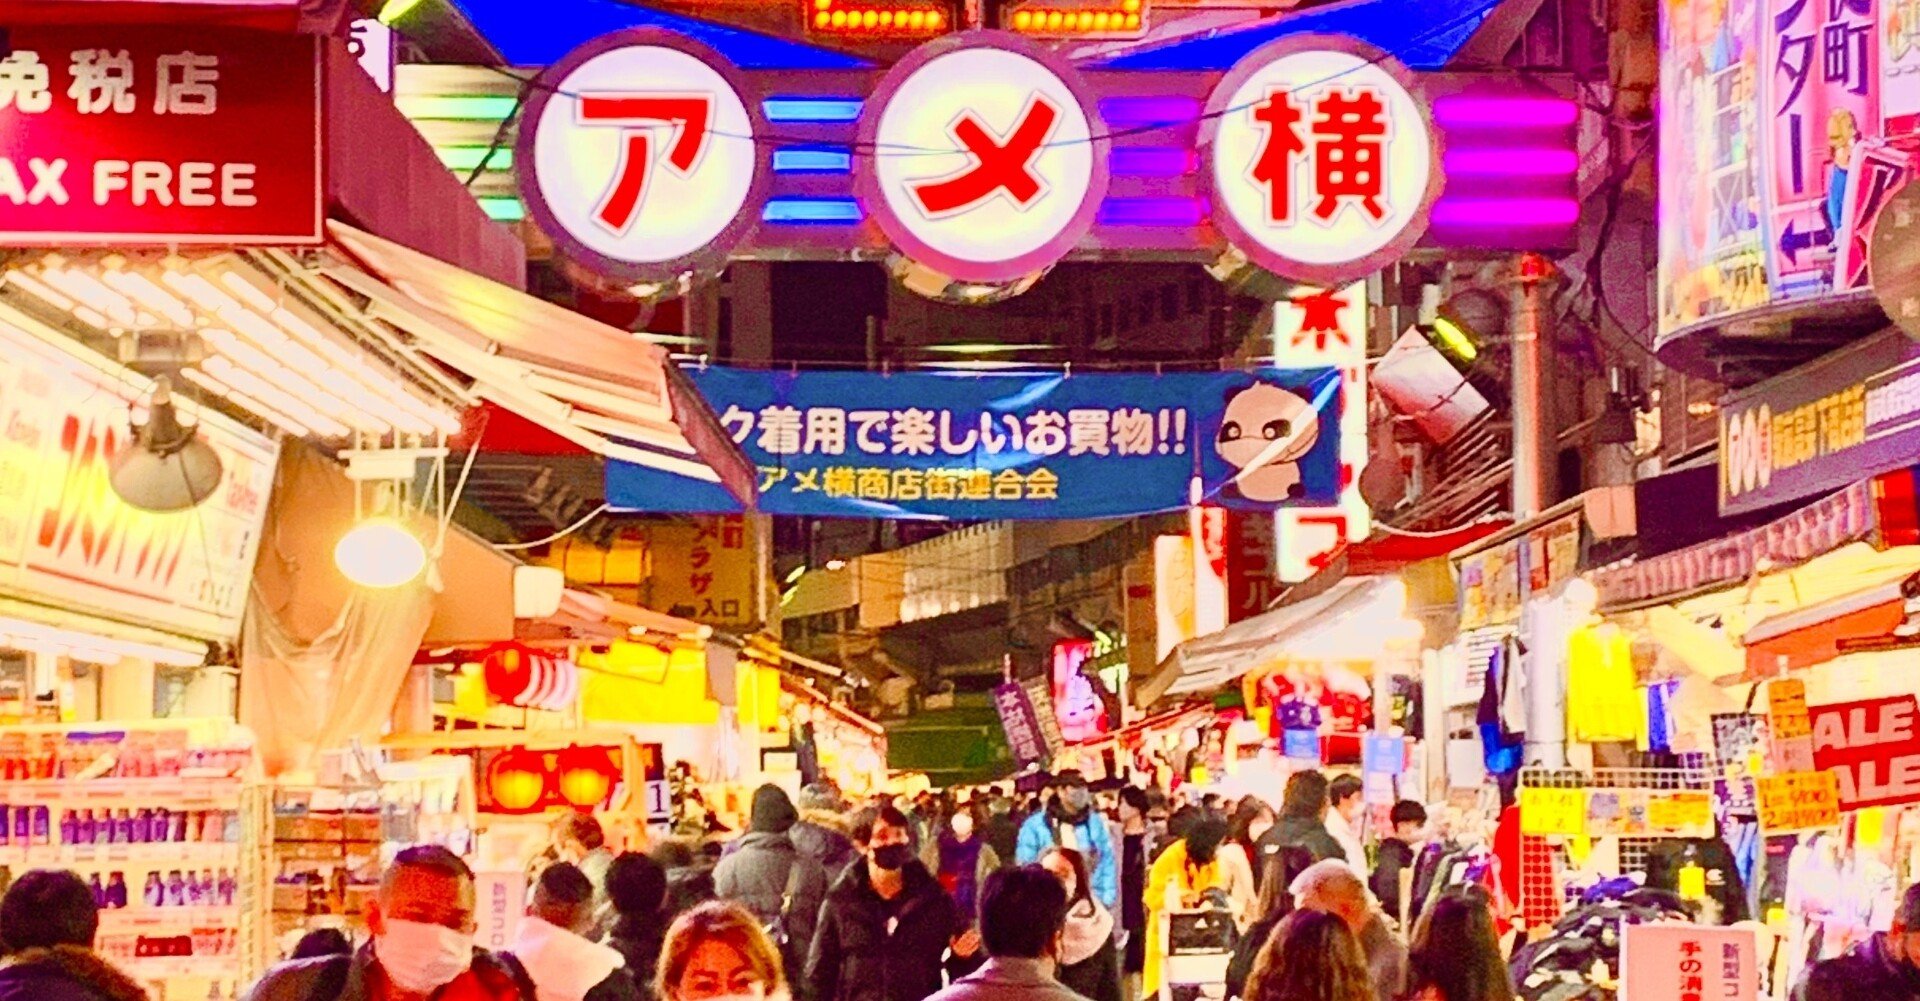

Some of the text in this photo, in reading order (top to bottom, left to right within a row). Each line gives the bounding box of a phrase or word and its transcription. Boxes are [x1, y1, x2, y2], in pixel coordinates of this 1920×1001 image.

[0, 49, 218, 115] 免税店
[93, 160, 258, 207] FREE
[577, 84, 1391, 237] アメ横
[757, 465, 1059, 501] アメ横商店街連合会
[700, 598, 740, 618] 入口
